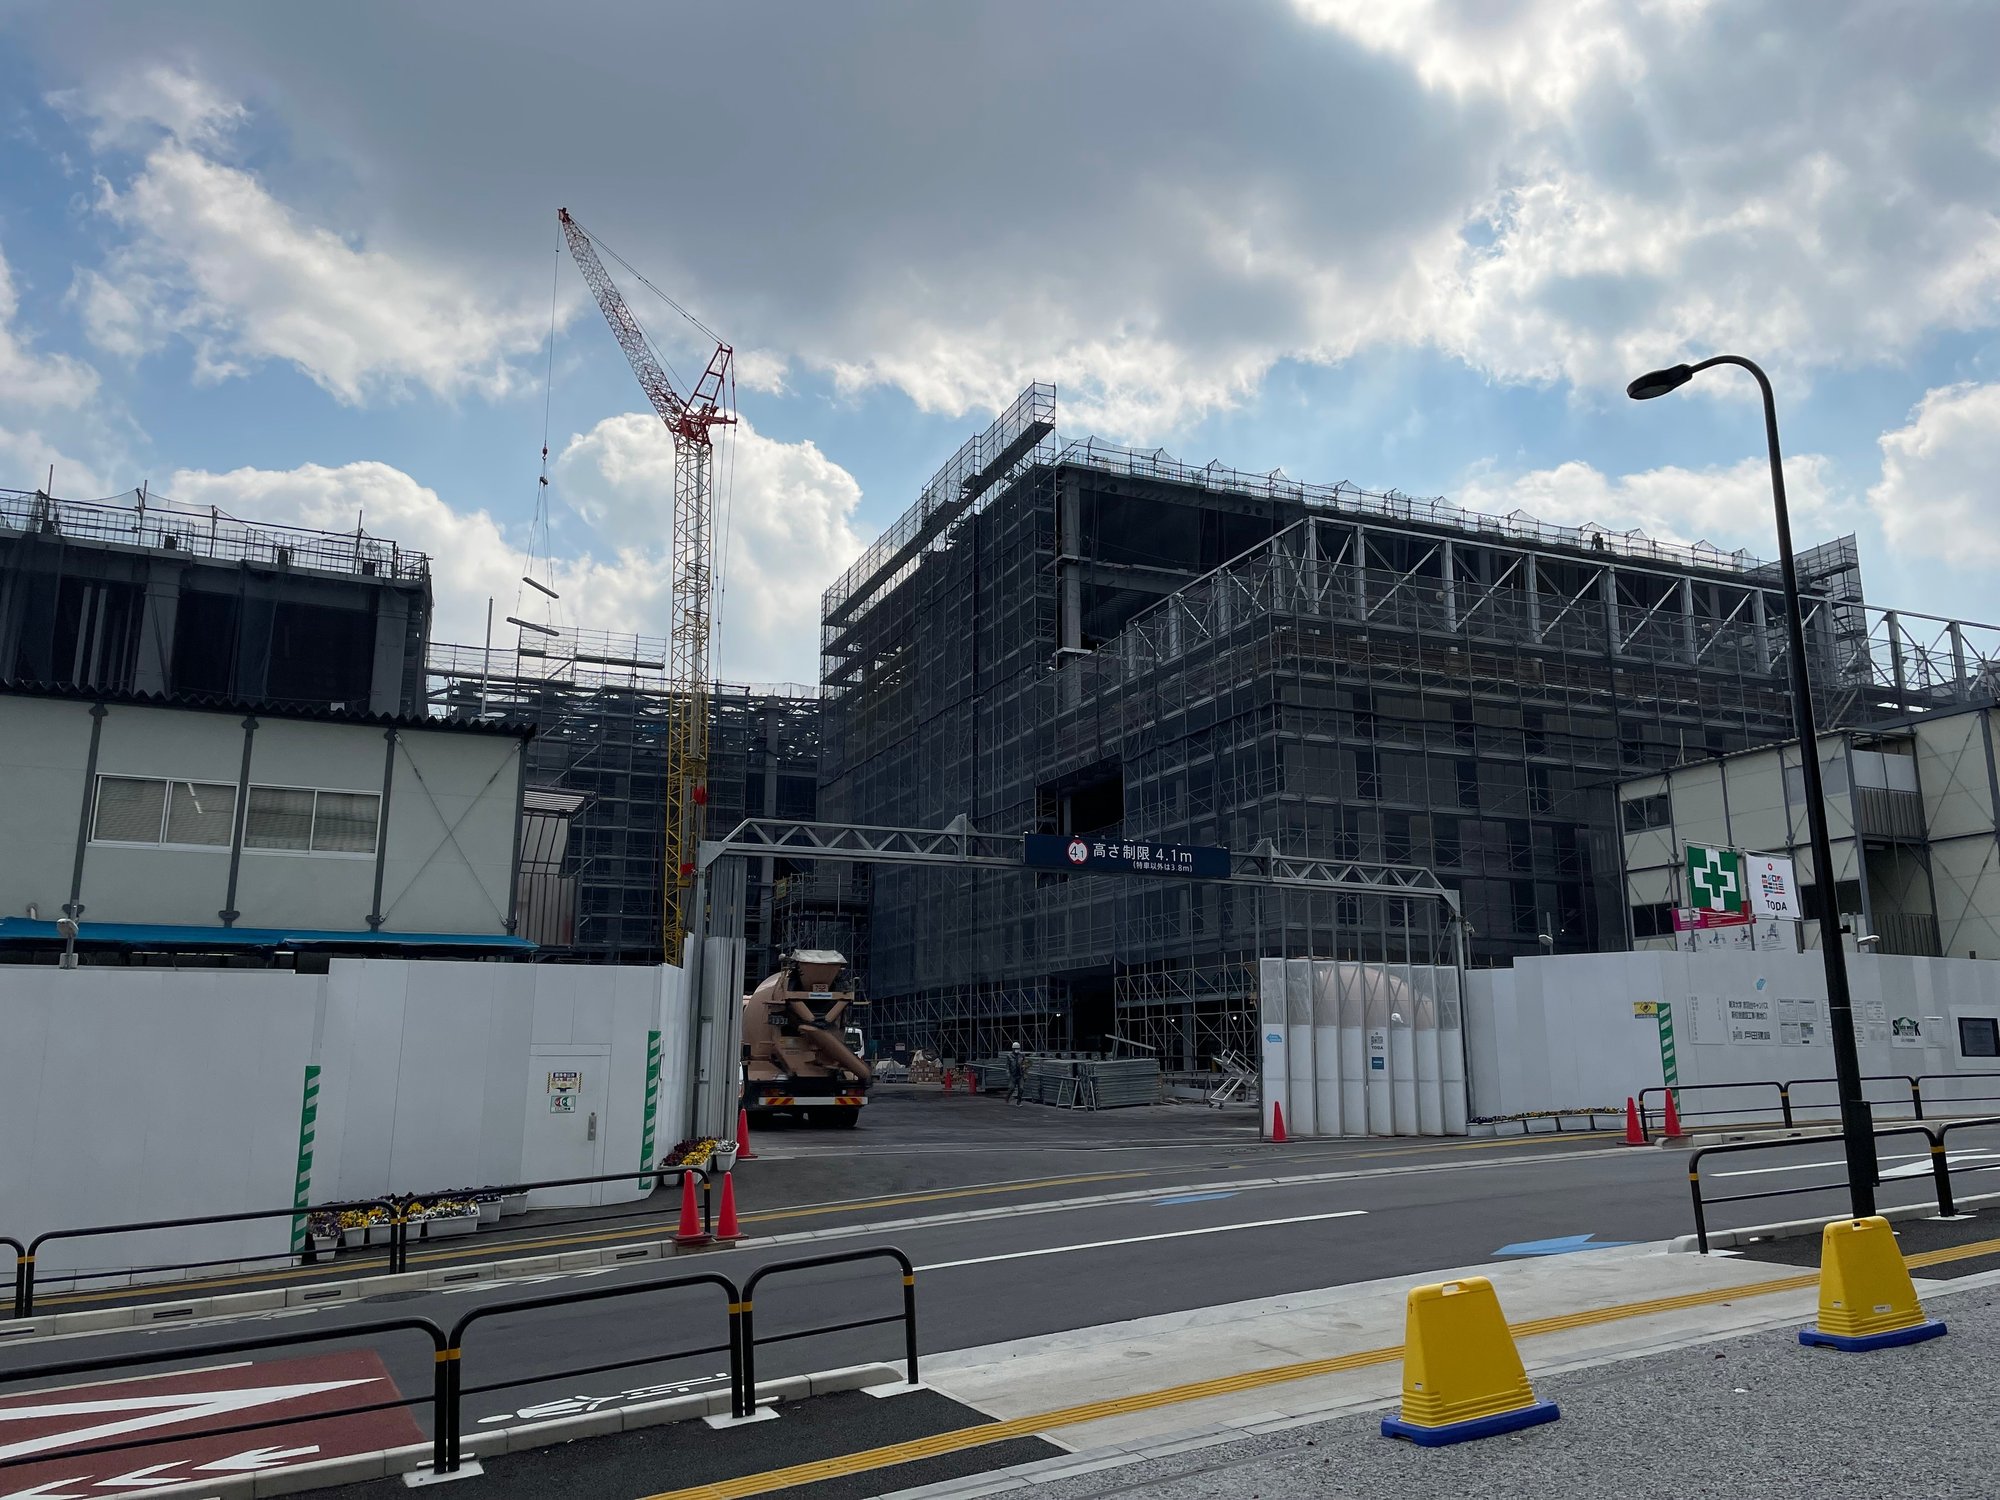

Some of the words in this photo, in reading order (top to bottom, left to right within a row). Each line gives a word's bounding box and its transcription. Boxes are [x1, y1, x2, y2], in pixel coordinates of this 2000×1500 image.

[1093, 842, 1150, 860] 高さ制限
[1155, 848, 1192, 863] 4.1m
[1766, 899, 1788, 911] TODA
